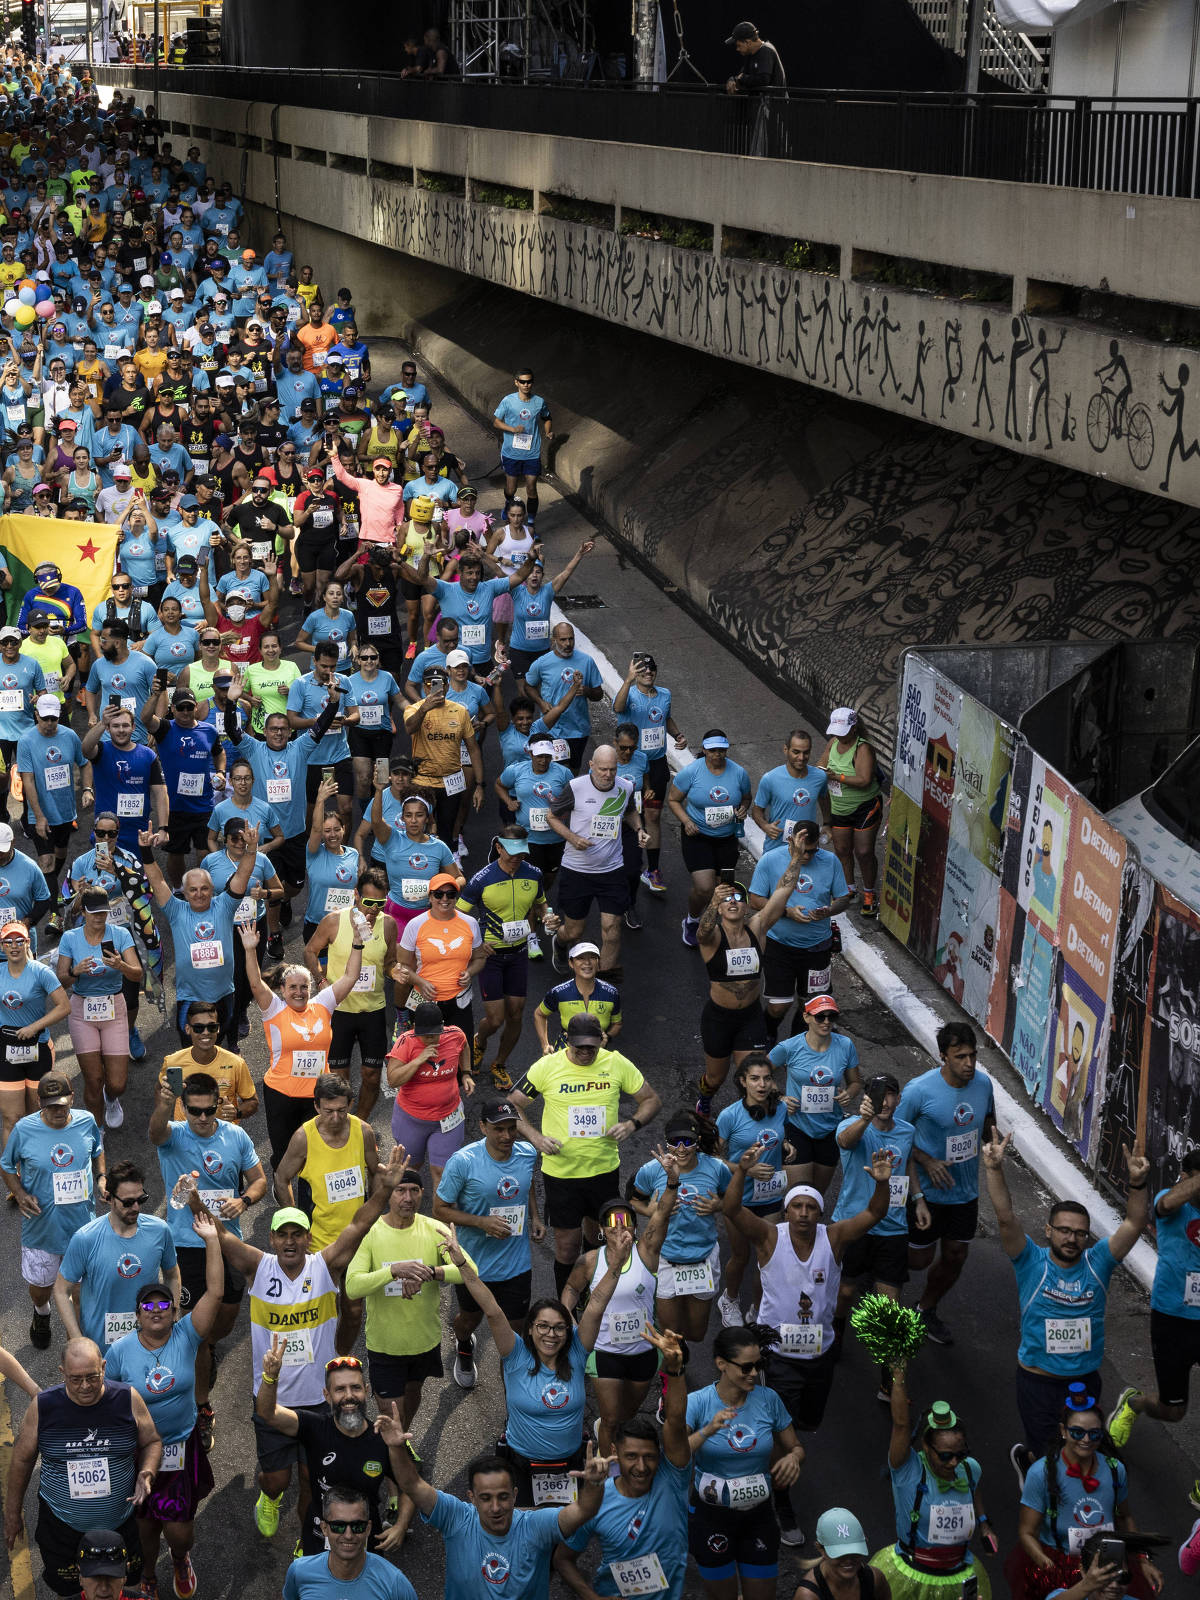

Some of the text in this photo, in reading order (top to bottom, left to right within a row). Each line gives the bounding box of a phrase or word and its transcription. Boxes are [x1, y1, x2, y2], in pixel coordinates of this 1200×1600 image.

[907, 683, 922, 706] SÃO
[905, 700, 926, 728] PAULO
[908, 718, 926, 746] TUDO
[120, 800, 140, 808] 11852
[593, 820, 616, 831] 15276
[1090, 830, 1120, 868] BETANO
[404, 884, 428, 894] 25899
[328, 894, 350, 904] 22059
[1083, 884, 1112, 924] BETANO
[507, 926, 526, 938] 7321
[195, 948, 216, 959] 1886
[971, 950, 983, 966] SÃO
[1076, 936, 1105, 977] BETANO
[732, 955, 752, 967] 6079
[86, 1001, 108, 1014] 8475
[1020, 1028, 1036, 1058] NÃO
[10, 1044, 32, 1056] 8718
[296, 1057, 318, 1069] 7187
[558, 1081, 610, 1094] RunFun
[806, 1092, 830, 1104] 8033
[574, 1114, 598, 1126] 3498
[950, 1138, 972, 1153] 8020
[56, 1178, 84, 1192] 14771
[328, 1176, 358, 1191] 16049
[756, 1178, 784, 1193] 12184
[675, 1269, 706, 1282] 20793
[269, 1308, 320, 1326] DANTE
[108, 1320, 139, 1333] 20434
[614, 1318, 640, 1333] 6760
[781, 1332, 816, 1345] 11212
[1048, 1328, 1082, 1340] 26021
[71, 1469, 106, 1484] 15062
[535, 1480, 570, 1492] 13667
[732, 1484, 767, 1500] 25558
[936, 1516, 966, 1530] 3261
[619, 1566, 651, 1586] 6515
